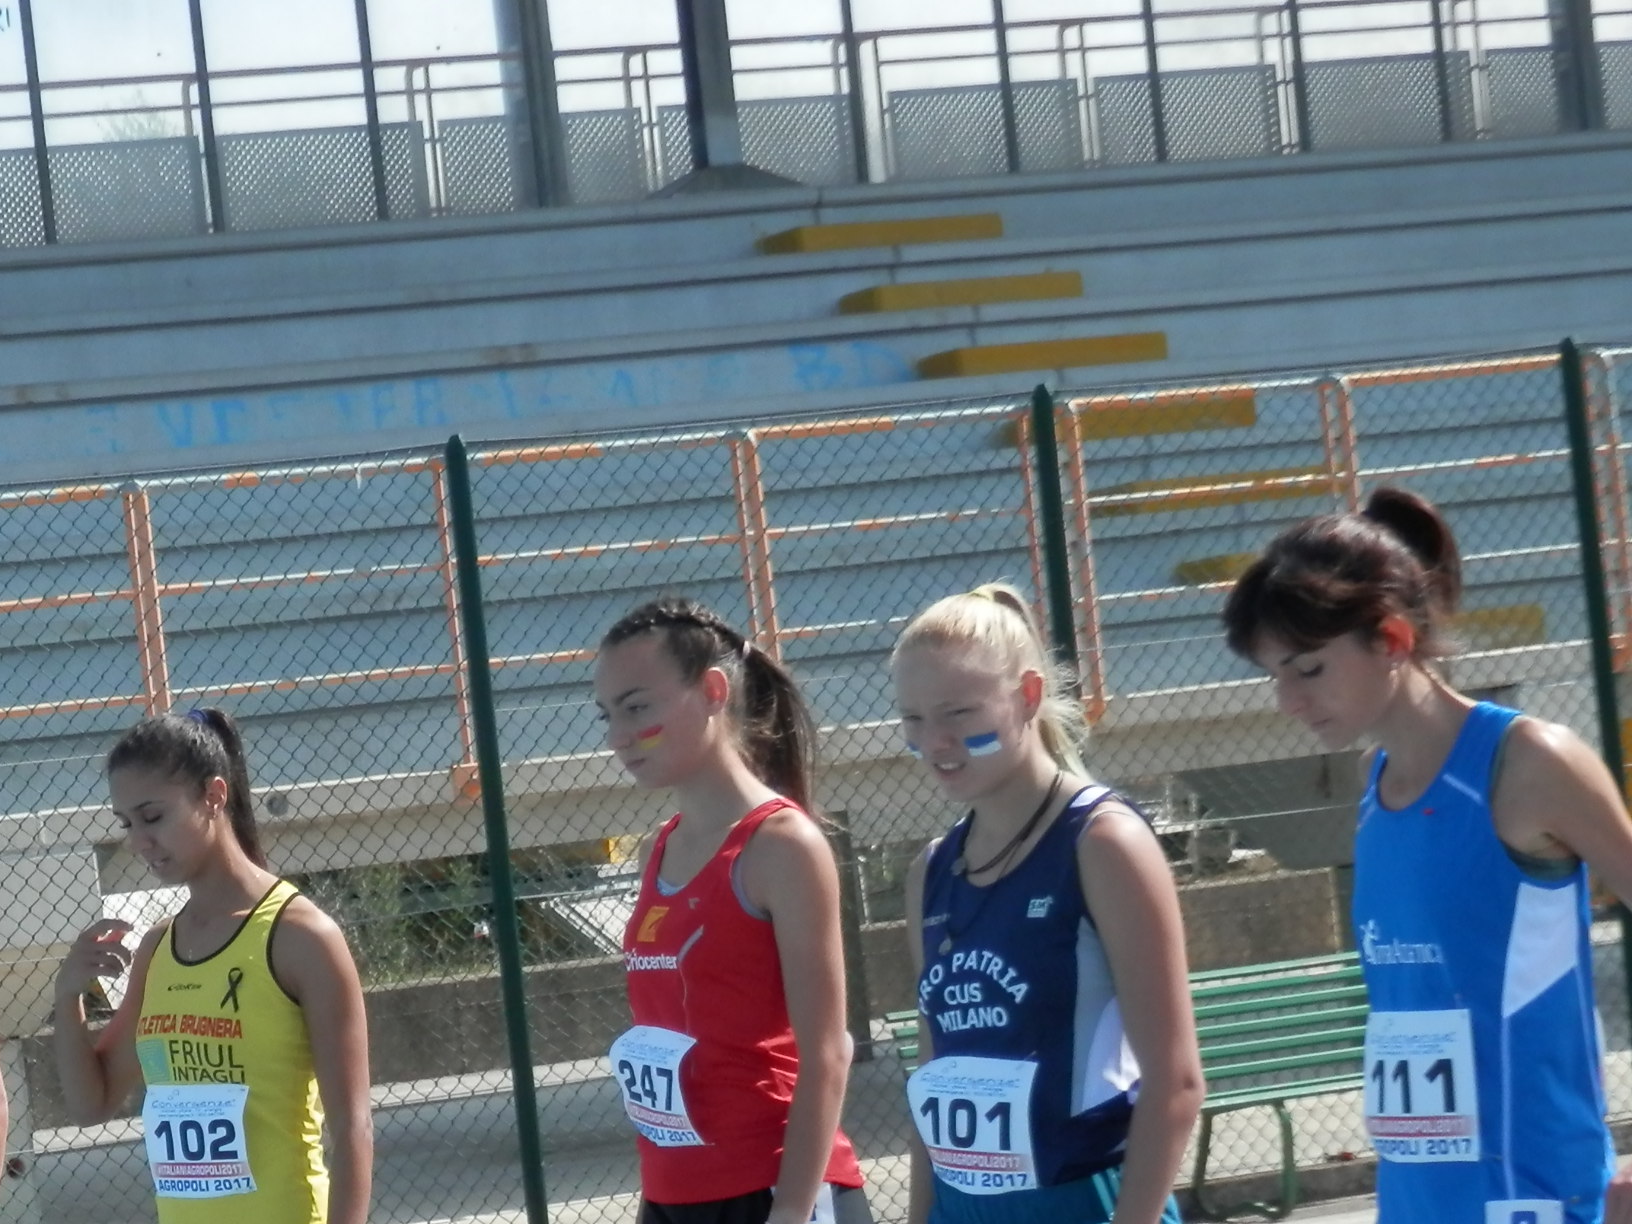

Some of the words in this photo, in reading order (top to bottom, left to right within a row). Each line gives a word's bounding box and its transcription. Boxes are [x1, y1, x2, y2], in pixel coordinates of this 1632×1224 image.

[951, 949, 1029, 1005] PATRIA
[943, 982, 983, 1006] CUS
[179, 1013, 243, 1039] BRUGNERA
[935, 1006, 1009, 1034] MILANO
[168, 1039, 245, 1069] FRIUL
[172, 1066, 246, 1085] INTAGLI
[618, 1059, 674, 1112] 247
[1371, 1057, 1458, 1115] 111
[667, 1127, 698, 1143] 2017
[919, 1096, 1012, 1152] 101
[154, 1118, 240, 1162] 102
[1426, 1138, 1472, 1156] 2017
[158, 1178, 210, 1193] AGROPOLI
[214, 1177, 252, 1192] 2017
[981, 1173, 1029, 1188] 2017
